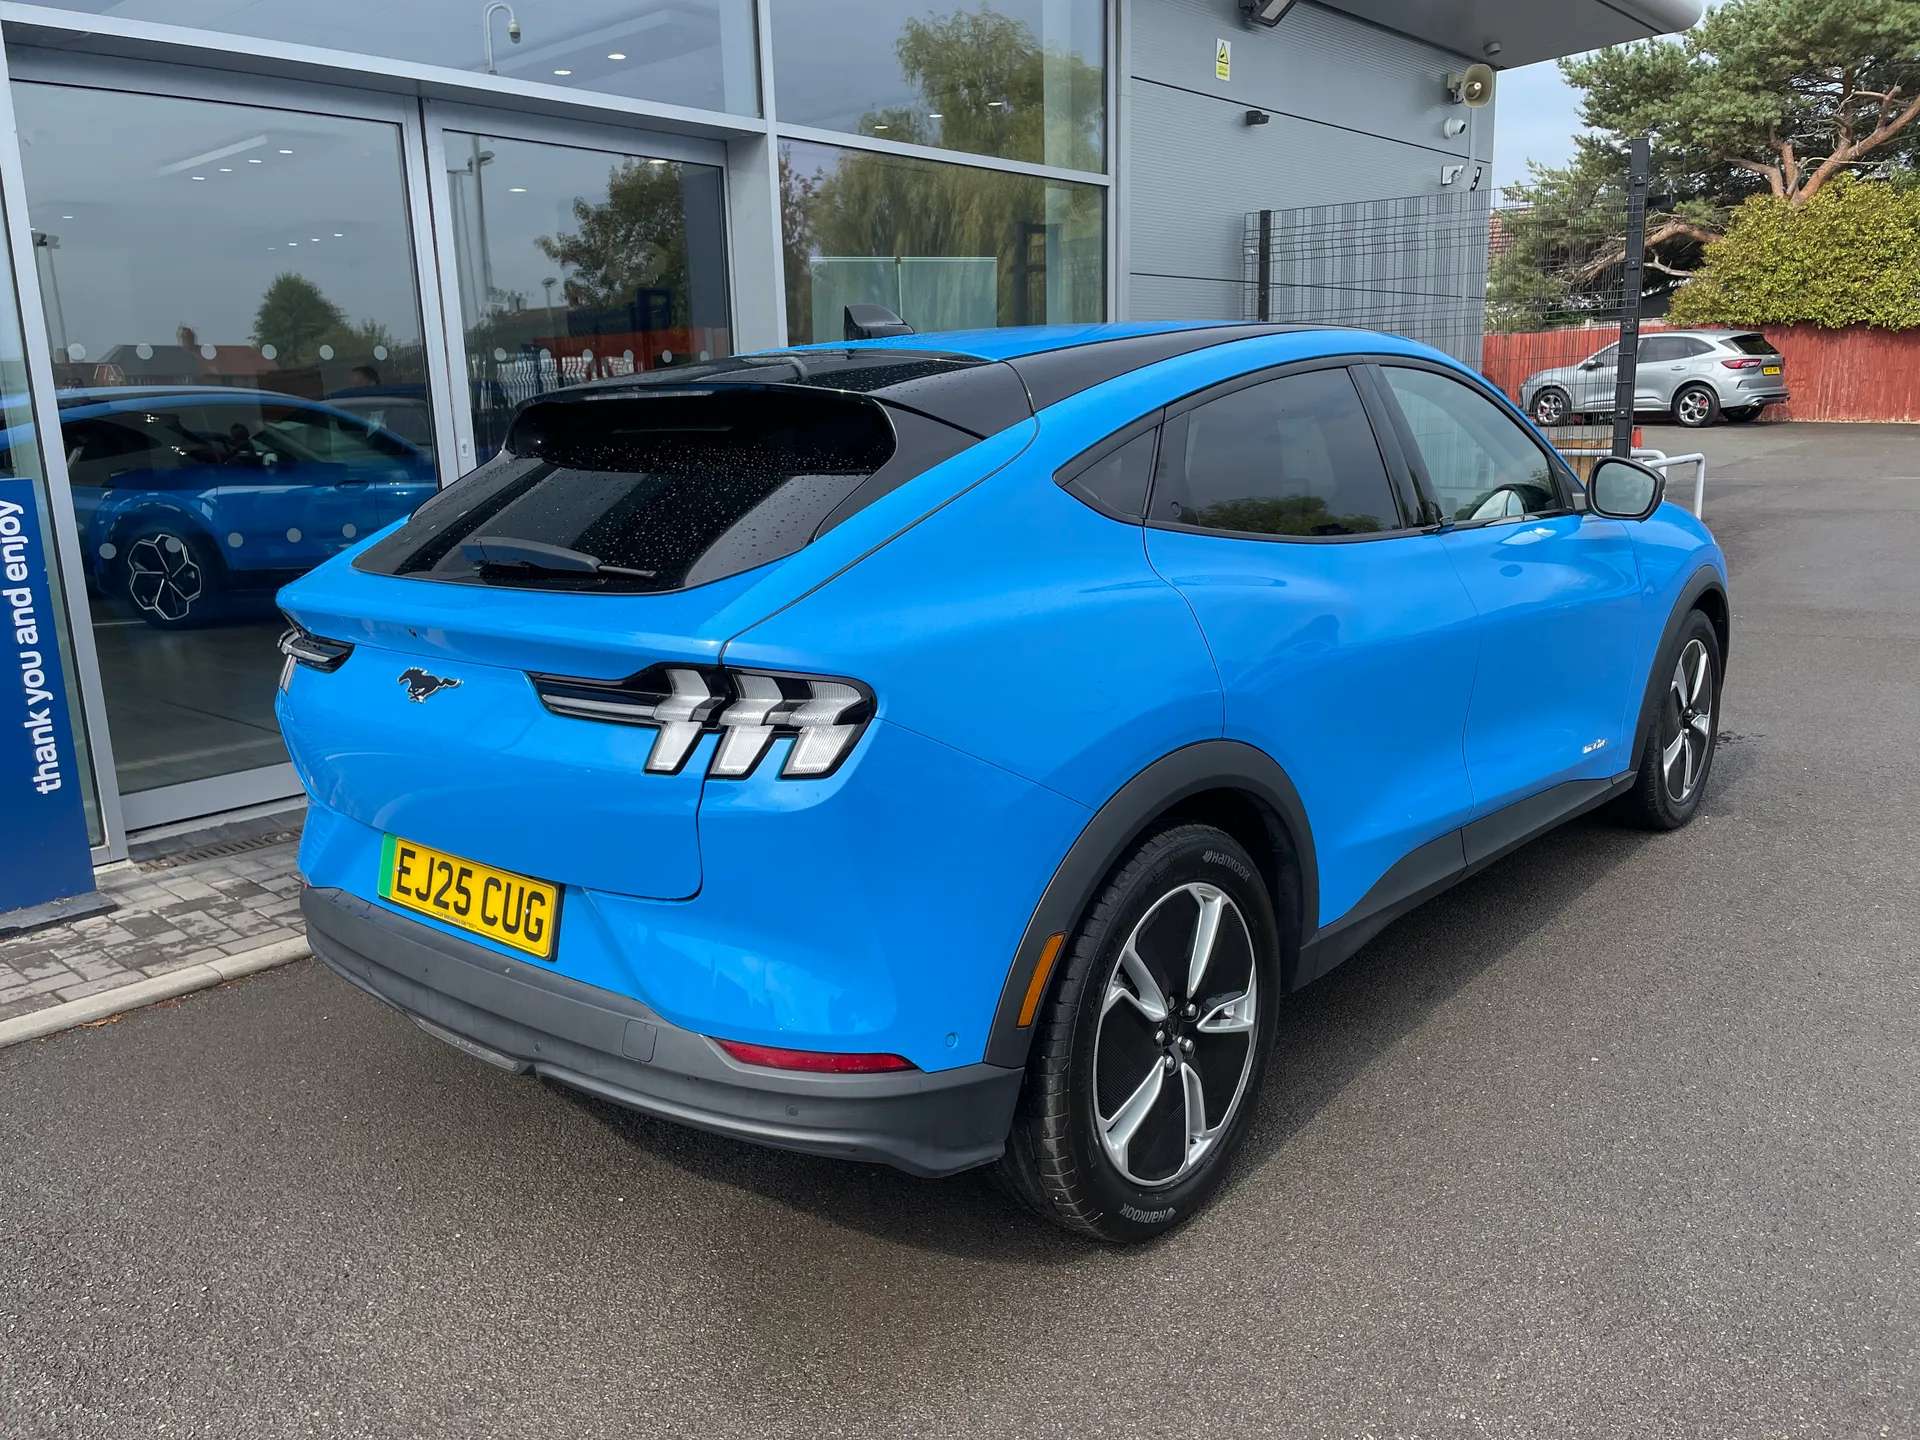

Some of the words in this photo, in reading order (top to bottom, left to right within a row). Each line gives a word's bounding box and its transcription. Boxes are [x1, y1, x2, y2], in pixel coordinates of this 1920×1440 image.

[0, 500, 28, 582] enjoy
[2, 587, 39, 645] and
[20, 650, 54, 706] you
[24, 707, 62, 795] thank
[396, 847, 474, 917] EJ25
[480, 876, 546, 943] CUG
